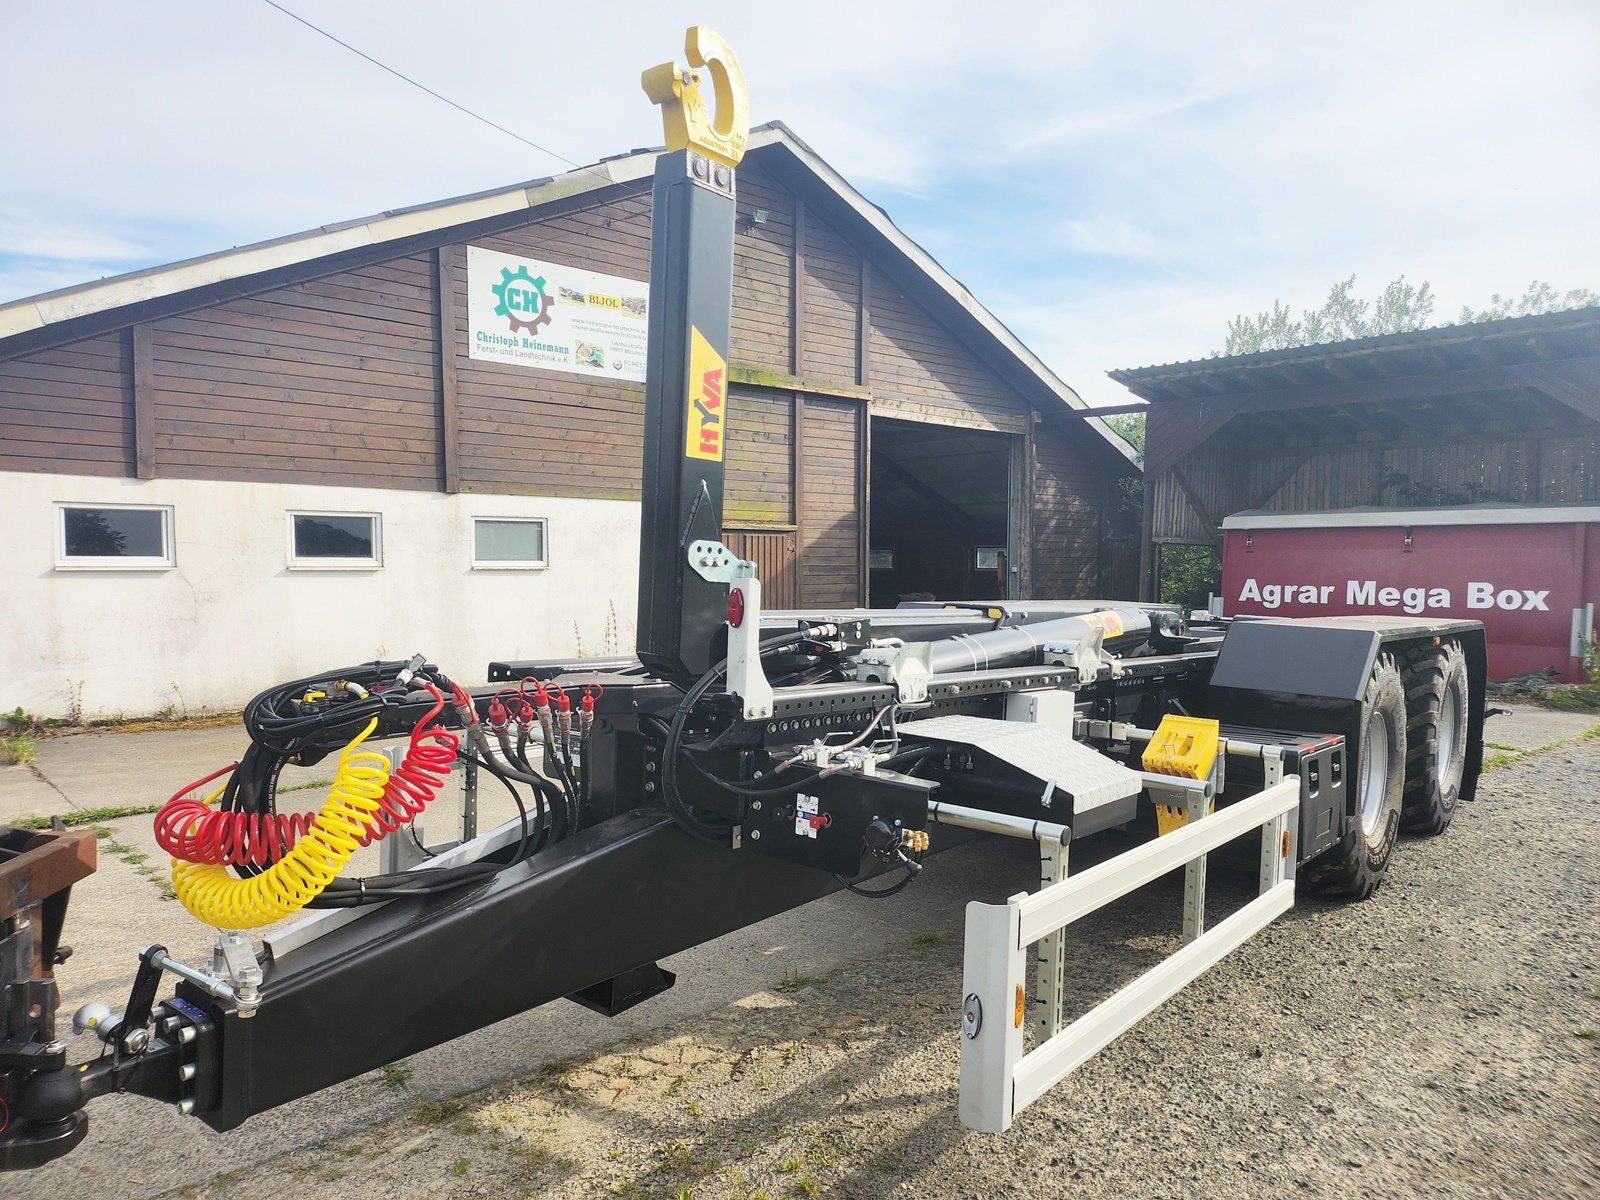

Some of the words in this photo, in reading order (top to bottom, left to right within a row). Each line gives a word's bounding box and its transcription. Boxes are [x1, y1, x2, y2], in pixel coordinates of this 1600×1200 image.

[507, 287, 539, 314] CH
[588, 294, 619, 309] BIJOL
[476, 331, 519, 348] Christoph
[522, 338, 570, 355] Heinemann
[476, 343, 498, 354] Forst-
[499, 348, 514, 357] und
[515, 350, 555, 362] Landtechnik
[693, 368, 722, 454] HYVA
[1238, 578, 1335, 609] Agrar
[1346, 580, 1451, 614] Mega
[1466, 582, 1550, 612] Box
